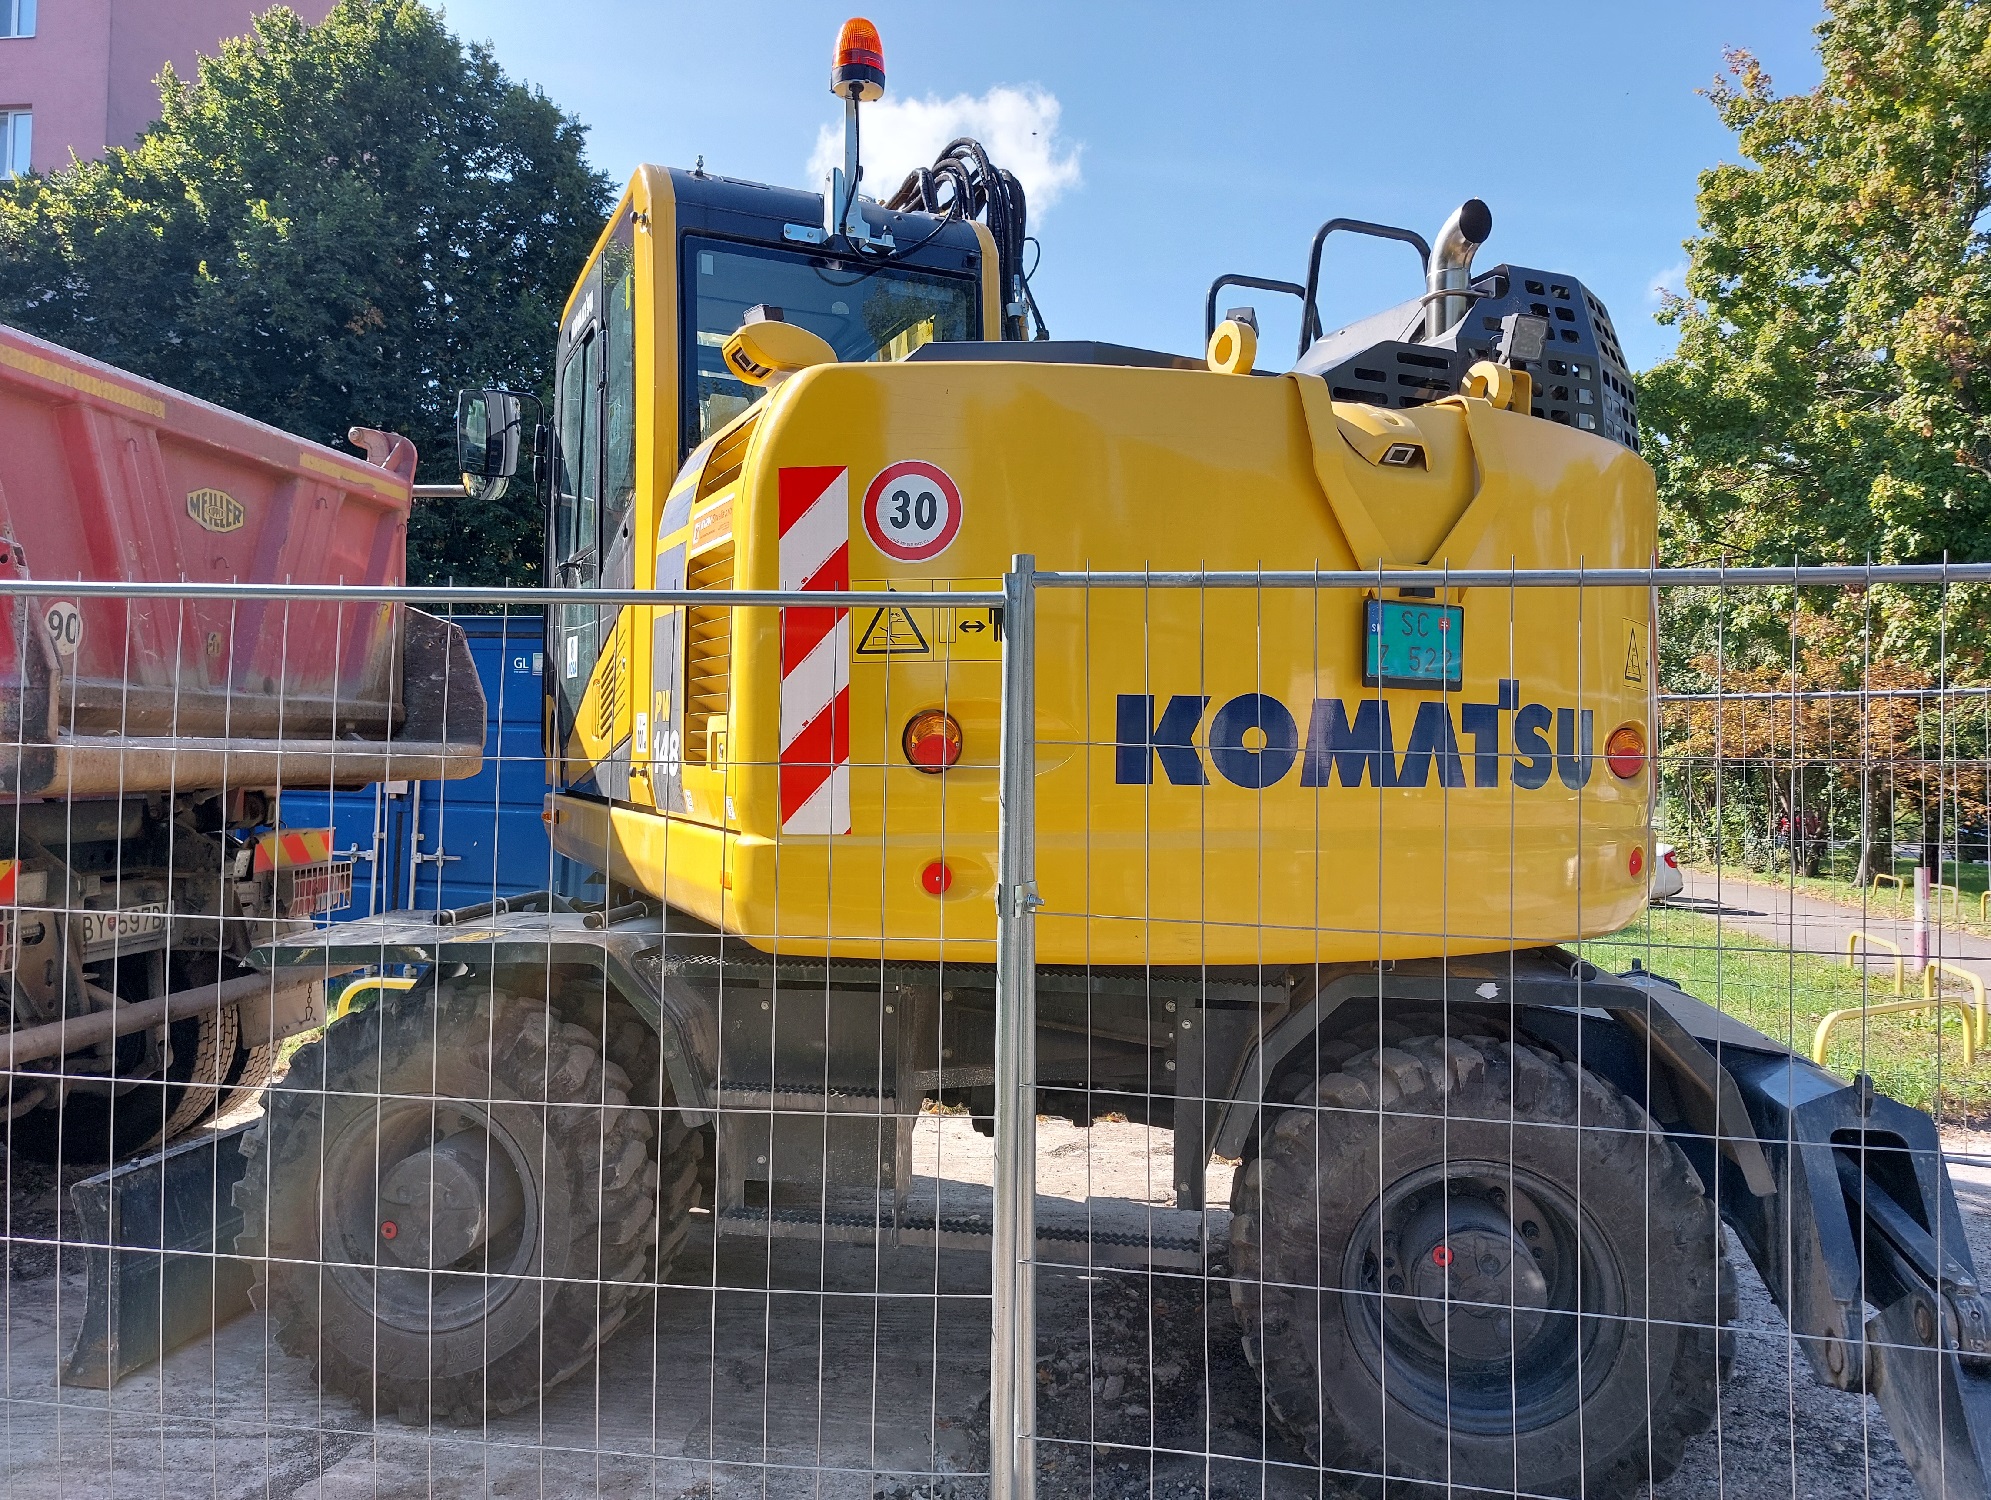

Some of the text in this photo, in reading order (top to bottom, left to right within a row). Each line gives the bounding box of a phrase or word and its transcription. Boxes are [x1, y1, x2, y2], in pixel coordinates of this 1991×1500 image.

[189, 492, 243, 529] MEILLER
[889, 490, 937, 530] 30
[49, 610, 80, 645] 90
[1401, 610, 1430, 638] SC
[513, 657, 530, 669] GL
[1376, 644, 1453, 675] Z 522
[1115, 679, 1594, 790] KOMATSU
[653, 729, 680, 777] 148
[82, 913, 106, 942] BY
